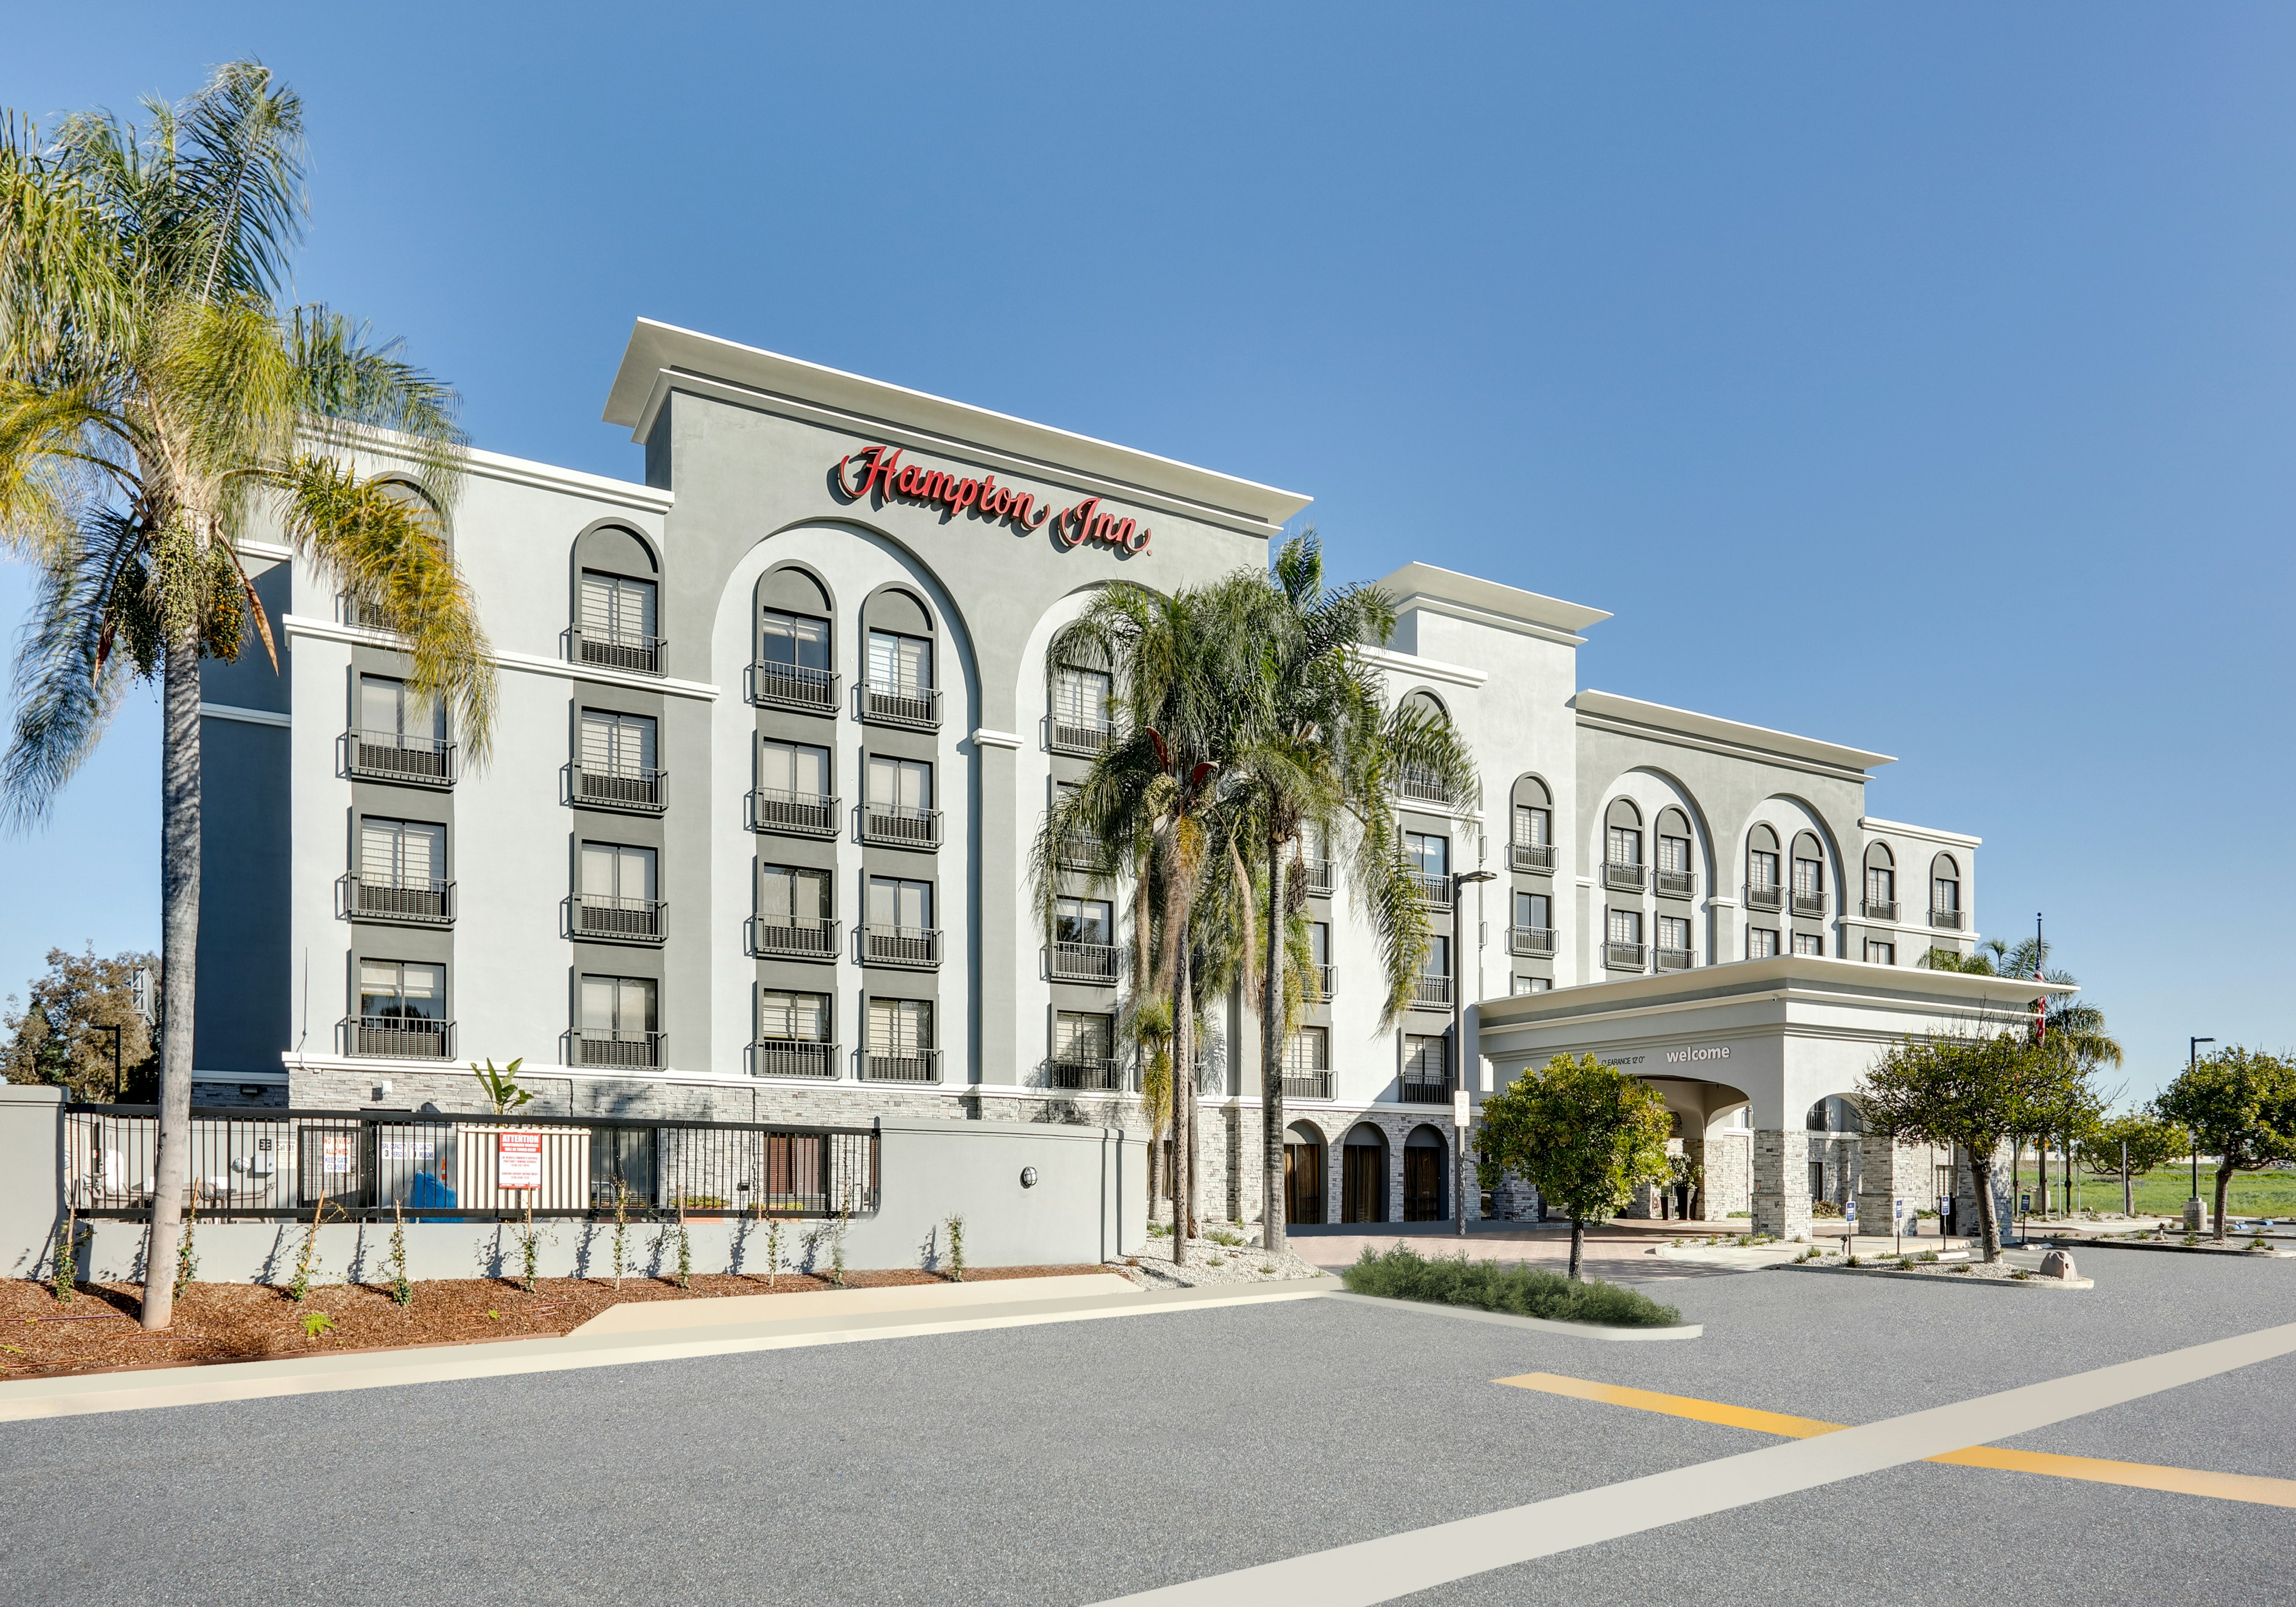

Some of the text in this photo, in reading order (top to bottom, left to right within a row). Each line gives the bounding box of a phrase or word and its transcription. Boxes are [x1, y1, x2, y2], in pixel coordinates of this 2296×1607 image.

[839, 446, 1151, 555] Hampton Inn
[1667, 1046, 1730, 1063] welcome
[1602, 1057, 1631, 1066] CLEARANCE
[502, 1135, 538, 1143] ATTENTION
